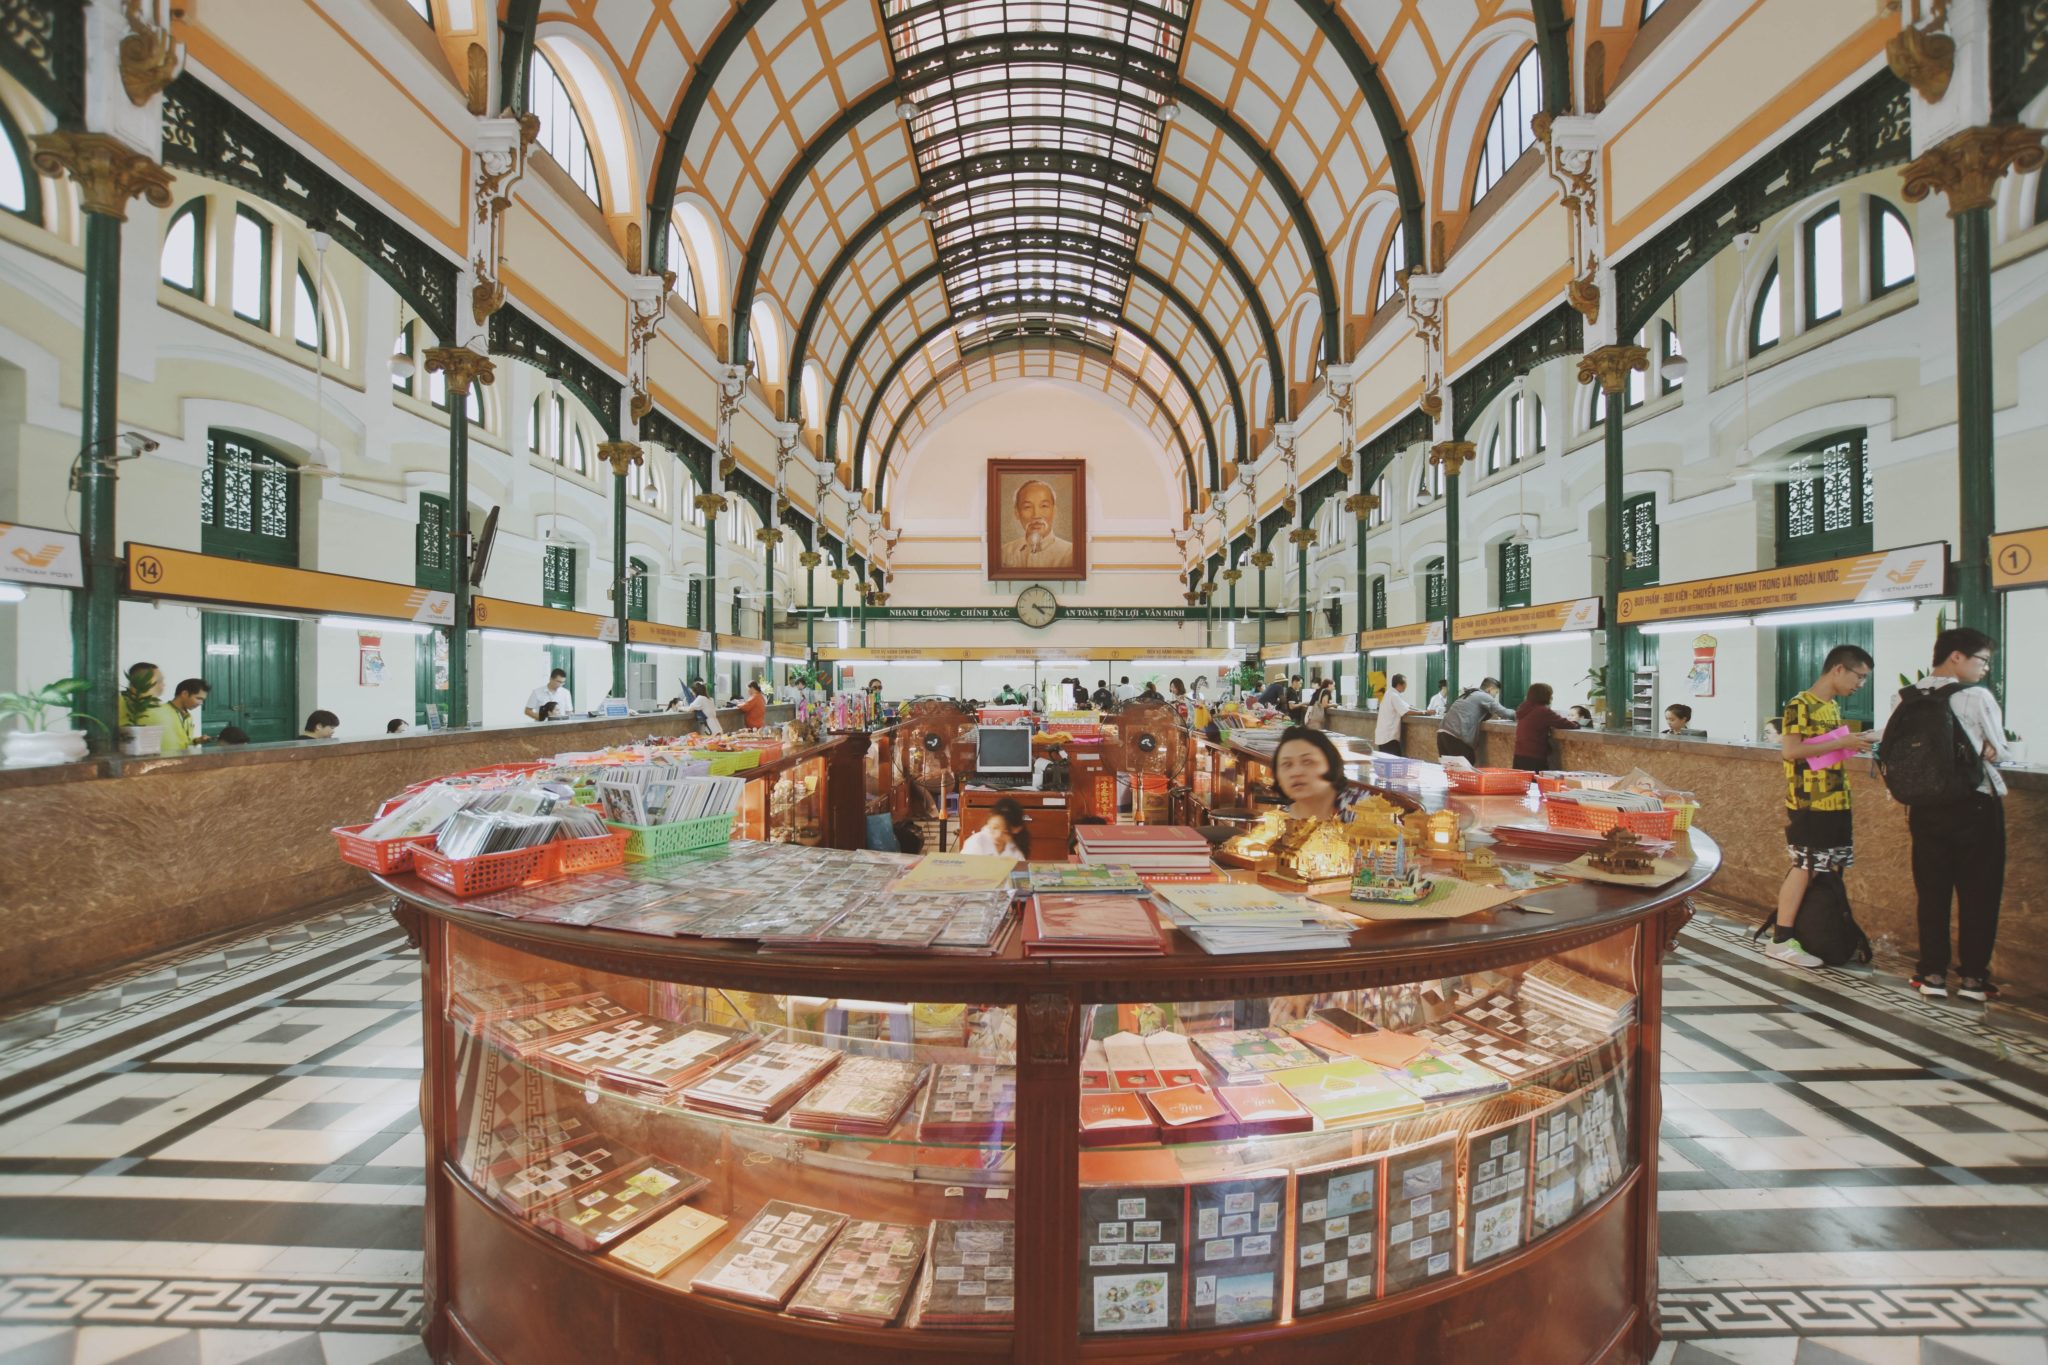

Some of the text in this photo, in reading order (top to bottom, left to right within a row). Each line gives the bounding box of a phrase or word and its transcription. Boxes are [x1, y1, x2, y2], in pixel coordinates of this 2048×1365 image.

[2007, 551, 2017, 569] 1
[4, 566, 73, 579] VIETNAM POST
[139, 561, 158, 579] 14
[1693, 583, 1715, 600] CHUYỂN
[1717, 580, 1733, 596] PHÁT
[1734, 580, 1757, 594] NHANH
[1758, 577, 1780, 591] TRONG
[1782, 573, 1792, 588] VÀ
[1794, 570, 1816, 586] NGOÀI
[1817, 568, 1839, 584] NƯỚC
[1719, 599, 1737, 609] PARCELS
[1741, 596, 1762, 607] EXPRESS
[1763, 594, 1780, 604] POSTAL
[1781, 592, 1797, 602] ITEMS
[478, 607, 486, 618] 13
[889, 609, 919, 617] NHANH
[920, 607, 951, 617] CHÓNG
[960, 608, 989, 617] CHÍNH
[992, 608, 1010, 617] XÁC
[1064, 609, 1076, 617] AN
[1077, 608, 1099, 617] TOÀN
[1104, 608, 1124, 618] TIỆN
[1125, 608, 1139, 618] LỢI
[1145, 608, 1161, 617] VĂN
[1163, 609, 1185, 617] MINH
[1622, 602, 1629, 614] 2
[1206, 904, 1288, 913] YEARBOOK
